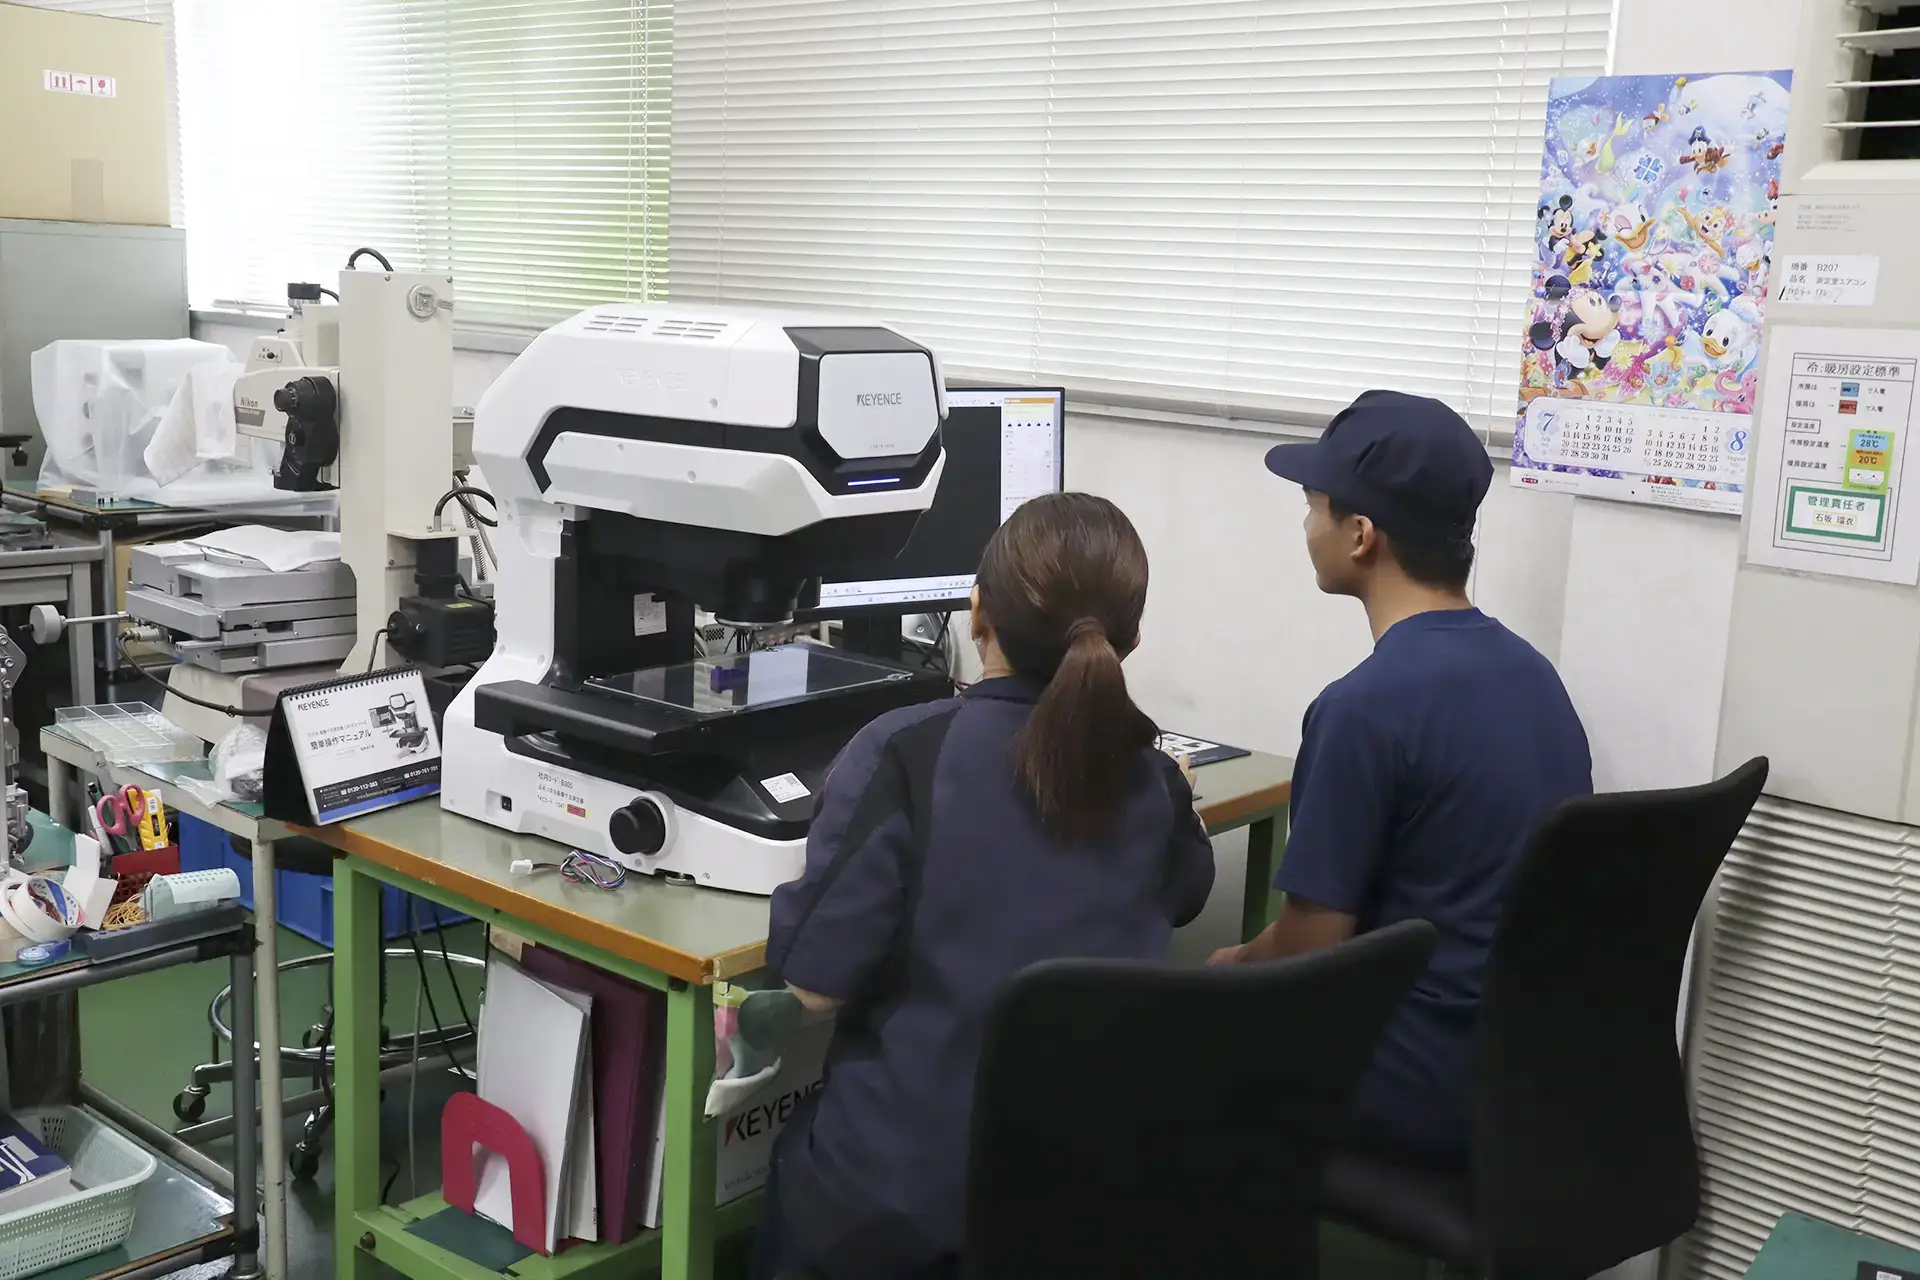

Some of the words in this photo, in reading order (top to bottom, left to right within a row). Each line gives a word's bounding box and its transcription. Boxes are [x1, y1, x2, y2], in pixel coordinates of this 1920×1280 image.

[1816, 263, 1839, 272] B207
[1789, 274, 1806, 284] 品名
[240, 397, 259, 407] Nikon
[856, 392, 902, 406] KEYENCE
[1543, 412, 1555, 432] 7
[1730, 430, 1747, 451] 8
[1612, 445, 1621, 453] 25
[1689, 443, 1696, 451] 14
[1700, 444, 1708, 452] 15
[1711, 445, 1719, 453] 16
[1654, 449, 1662, 457] 18
[1665, 450, 1674, 458] 19
[1697, 454, 1707, 462] 22
[1709, 455, 1718, 463] 23
[1674, 461, 1683, 469] 27
[1685, 462, 1694, 470] 28
[1696, 463, 1705, 471] 29
[1707, 464, 1717, 472] 30
[1807, 495, 1865, 511] 管理責任者
[298, 698, 330, 711] KEYENCE
[310, 729, 372, 750] 簡単操作マニュアル
